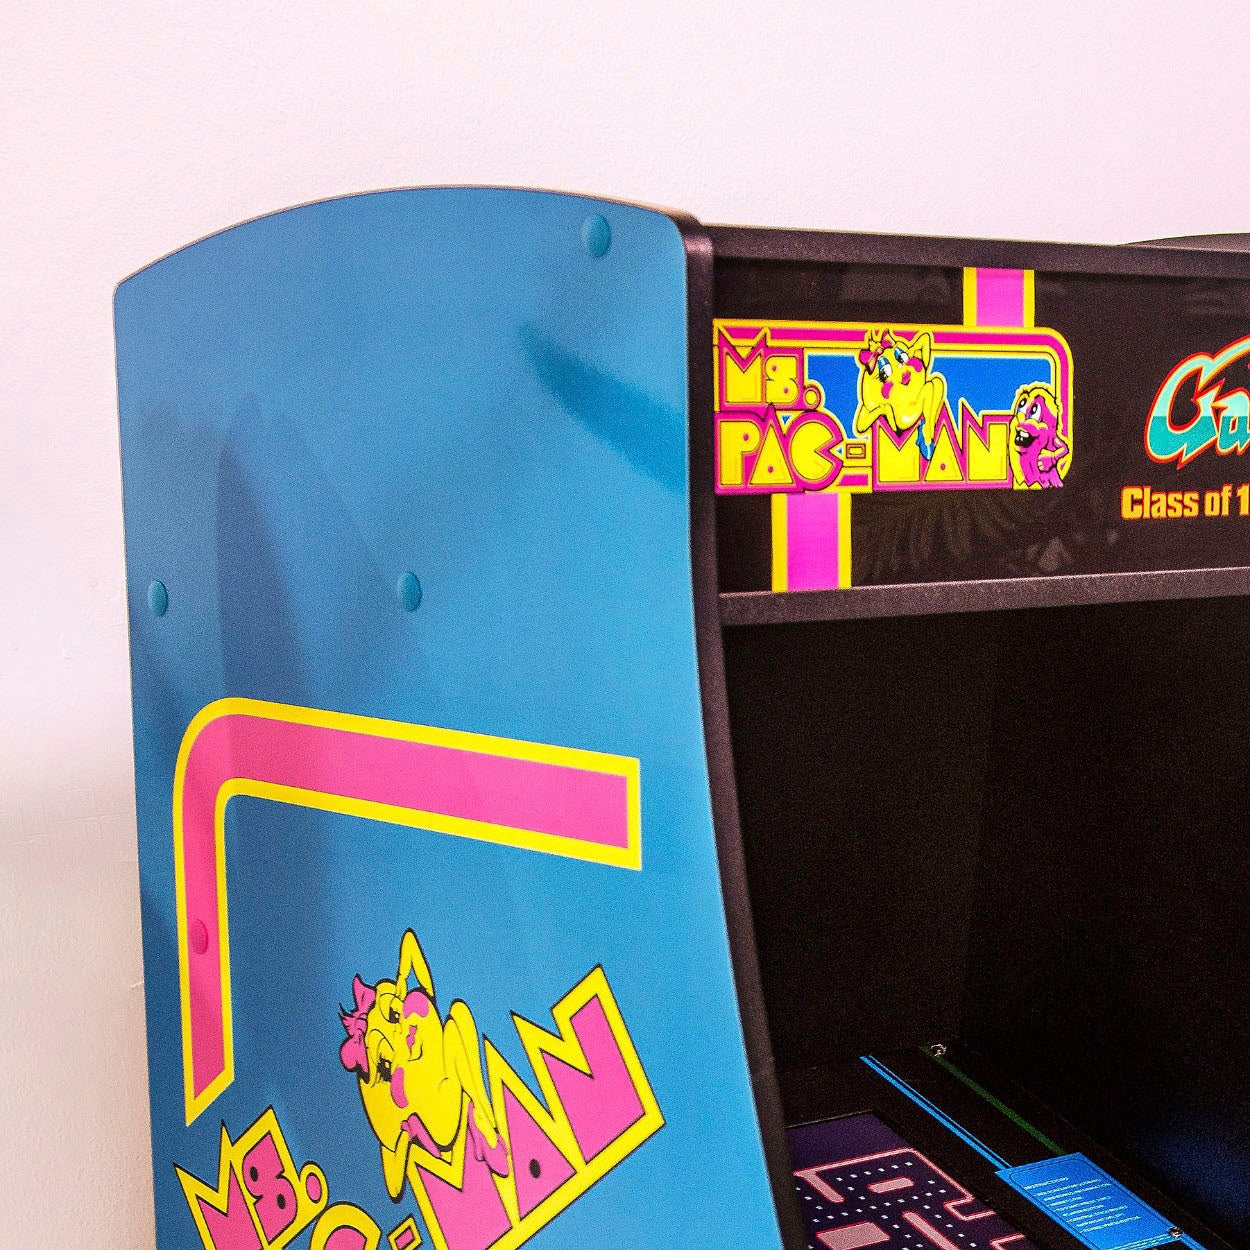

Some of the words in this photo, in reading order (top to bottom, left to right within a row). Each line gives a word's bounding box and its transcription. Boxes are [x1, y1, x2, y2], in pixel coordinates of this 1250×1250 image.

[714, 402, 1015, 494] PAC-MAN
[1120, 485, 1200, 520] Class
[1203, 482, 1234, 517] of
